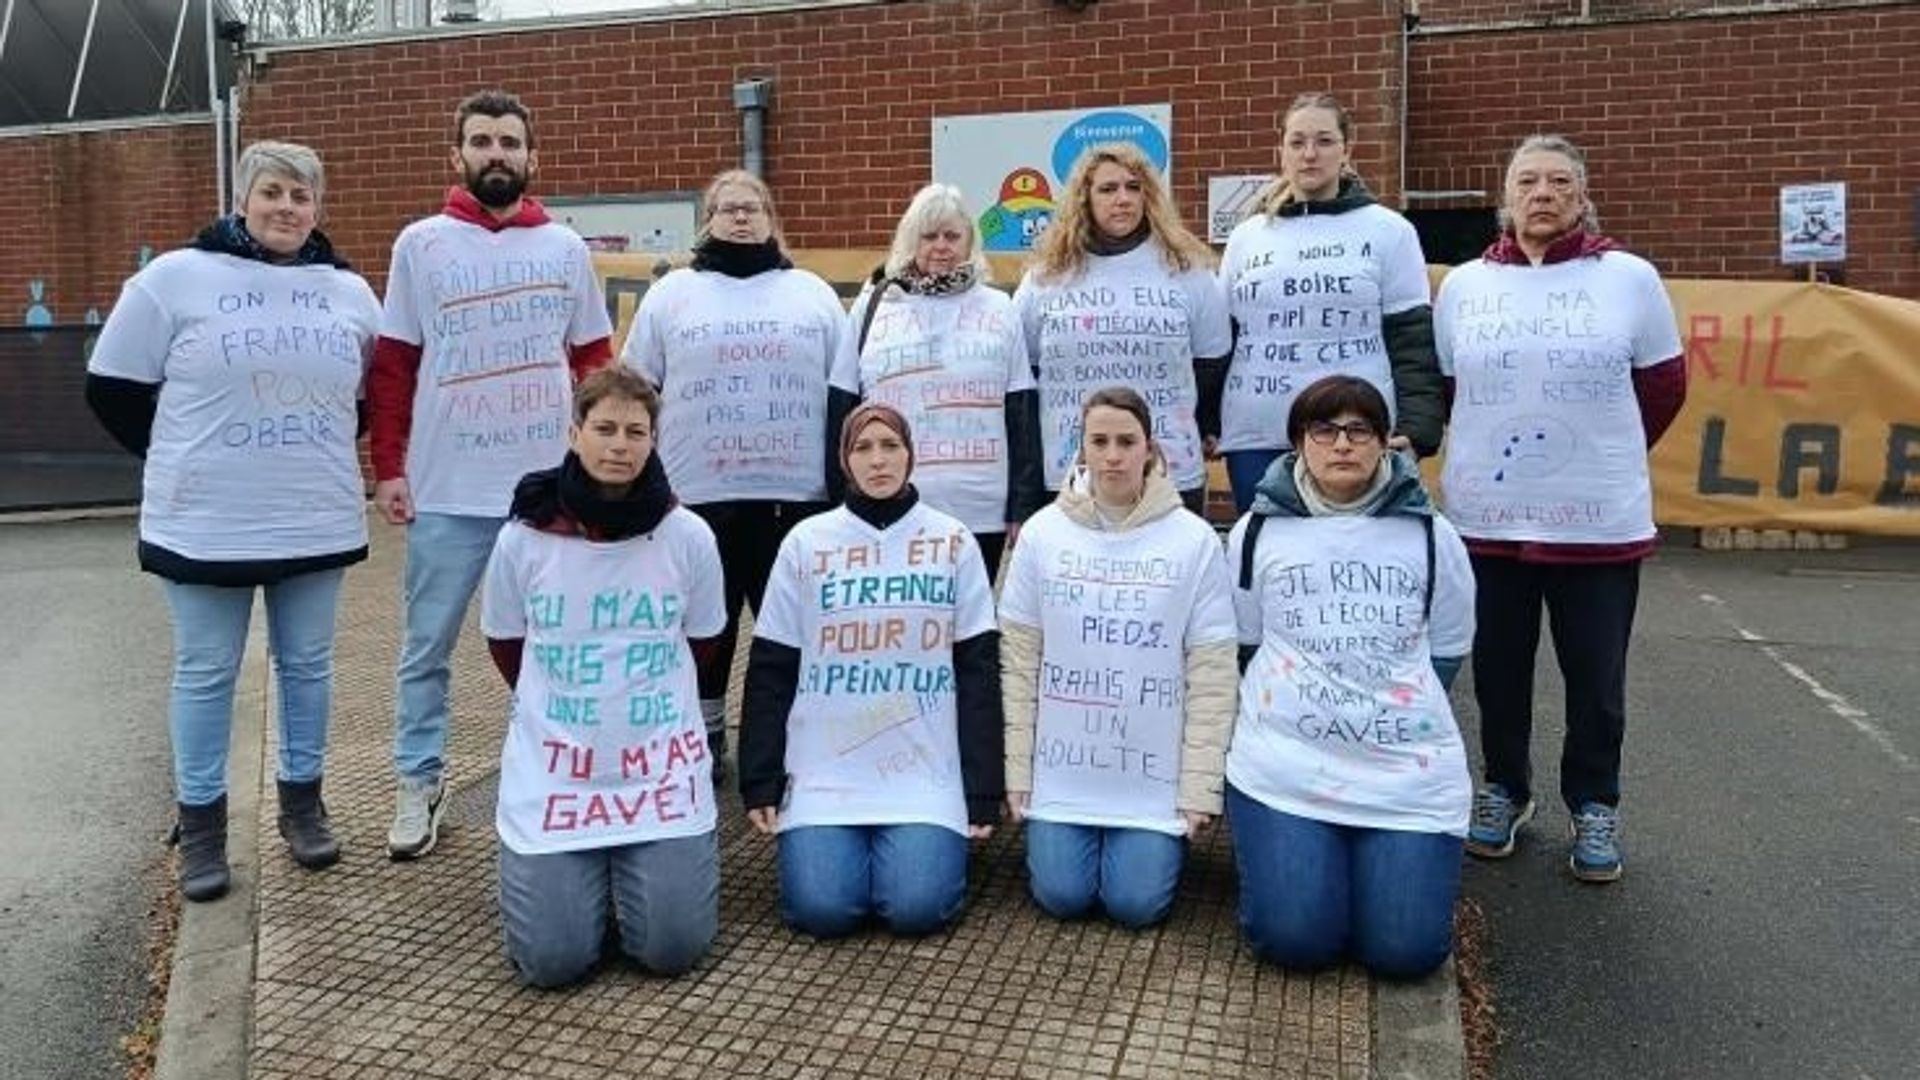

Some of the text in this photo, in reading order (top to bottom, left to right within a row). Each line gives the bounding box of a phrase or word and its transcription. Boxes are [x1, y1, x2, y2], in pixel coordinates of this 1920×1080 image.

[1298, 244, 1345, 260] NOUS
[218, 291, 266, 314] ON
[1268, 304, 1305, 329] PIPI
[1264, 342, 1302, 364] QUE
[1684, 313, 1809, 393] RIL
[680, 378, 717, 401] CAR
[1254, 375, 1293, 395] JUS
[1280, 563, 1317, 599] JE
[1097, 590, 1147, 612] LES
[818, 617, 906, 655] POUR
[824, 658, 958, 695] PEINTUR
[1085, 709, 1128, 739] UN
[1296, 707, 1413, 745] GAVÉE
[542, 729, 706, 783] TU M'AS
